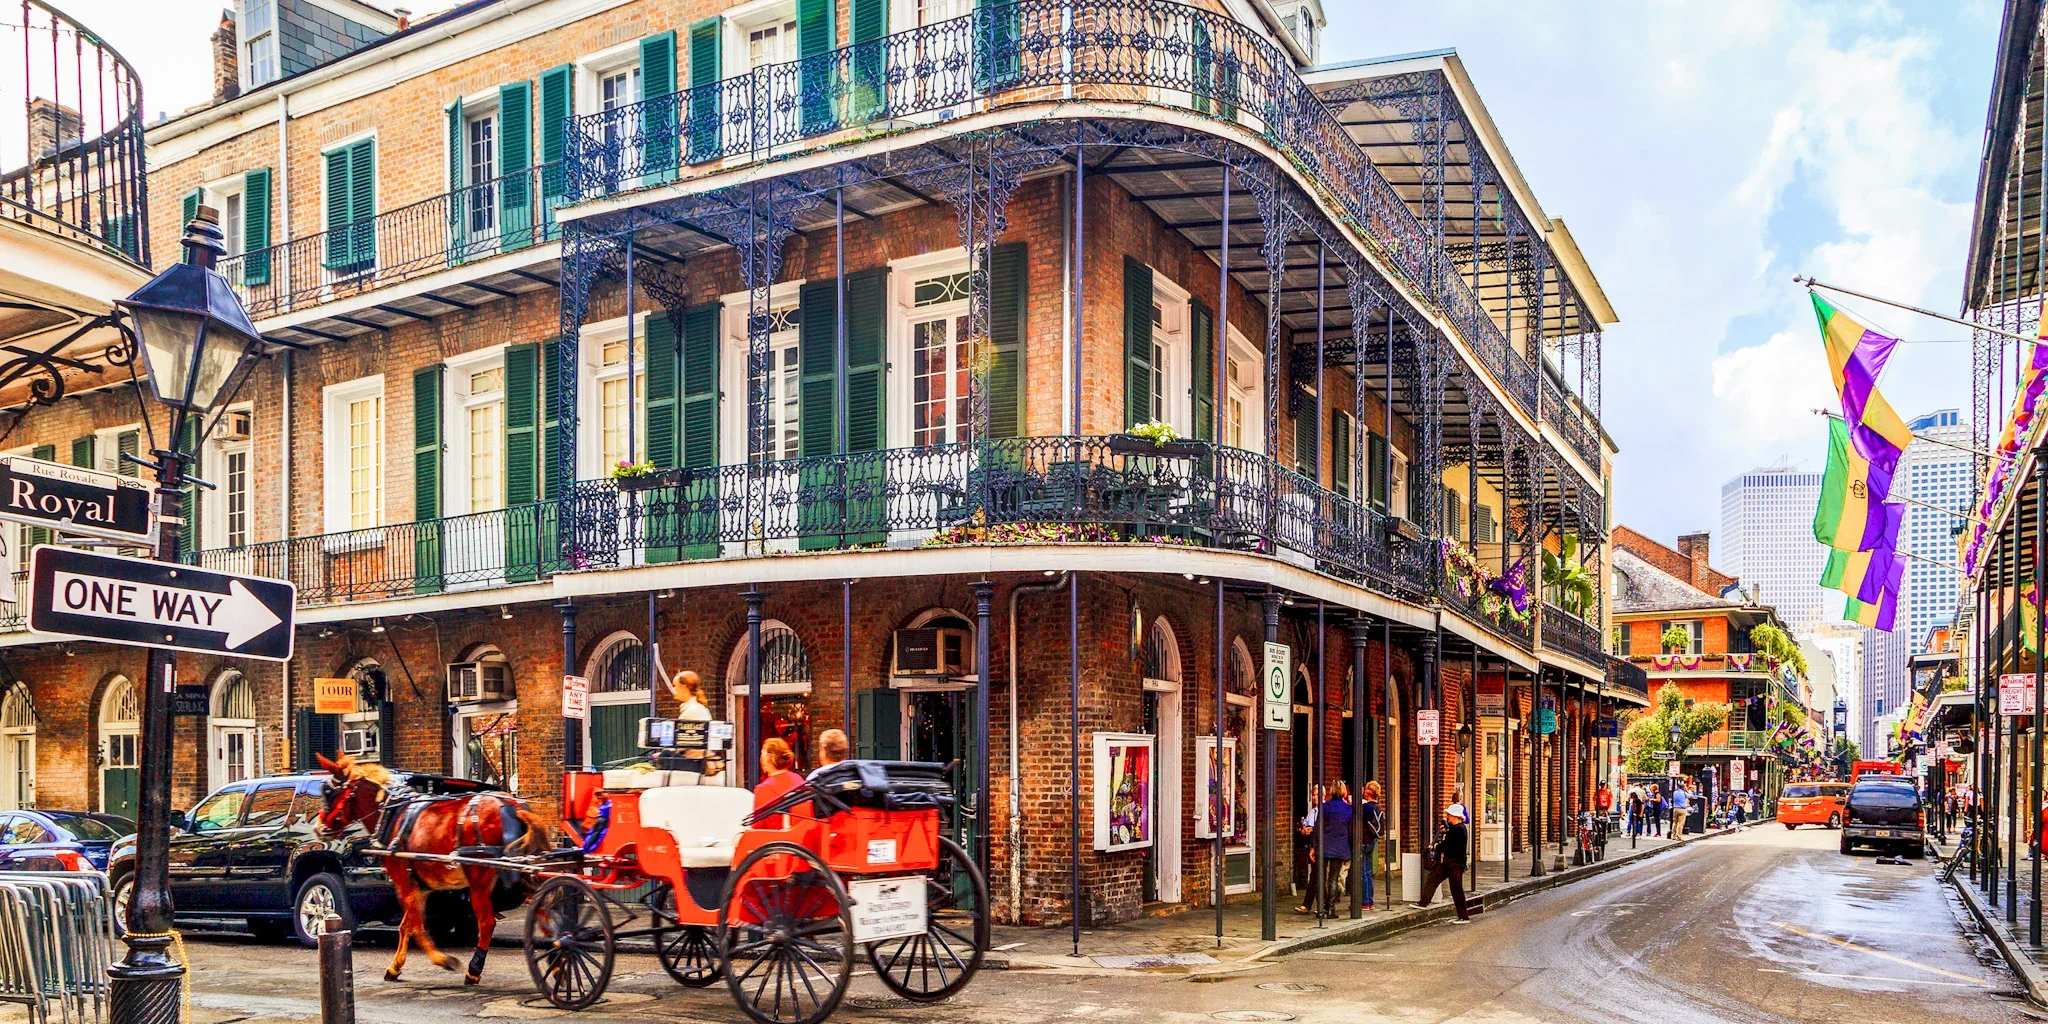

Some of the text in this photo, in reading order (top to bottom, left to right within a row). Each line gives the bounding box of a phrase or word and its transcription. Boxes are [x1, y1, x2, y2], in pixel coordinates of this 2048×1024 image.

[32, 464, 98, 484] Rue Royale
[8, 477, 117, 524] Royal
[64, 578, 223, 627] ONE WAY
[569, 698, 583, 706] TIME
